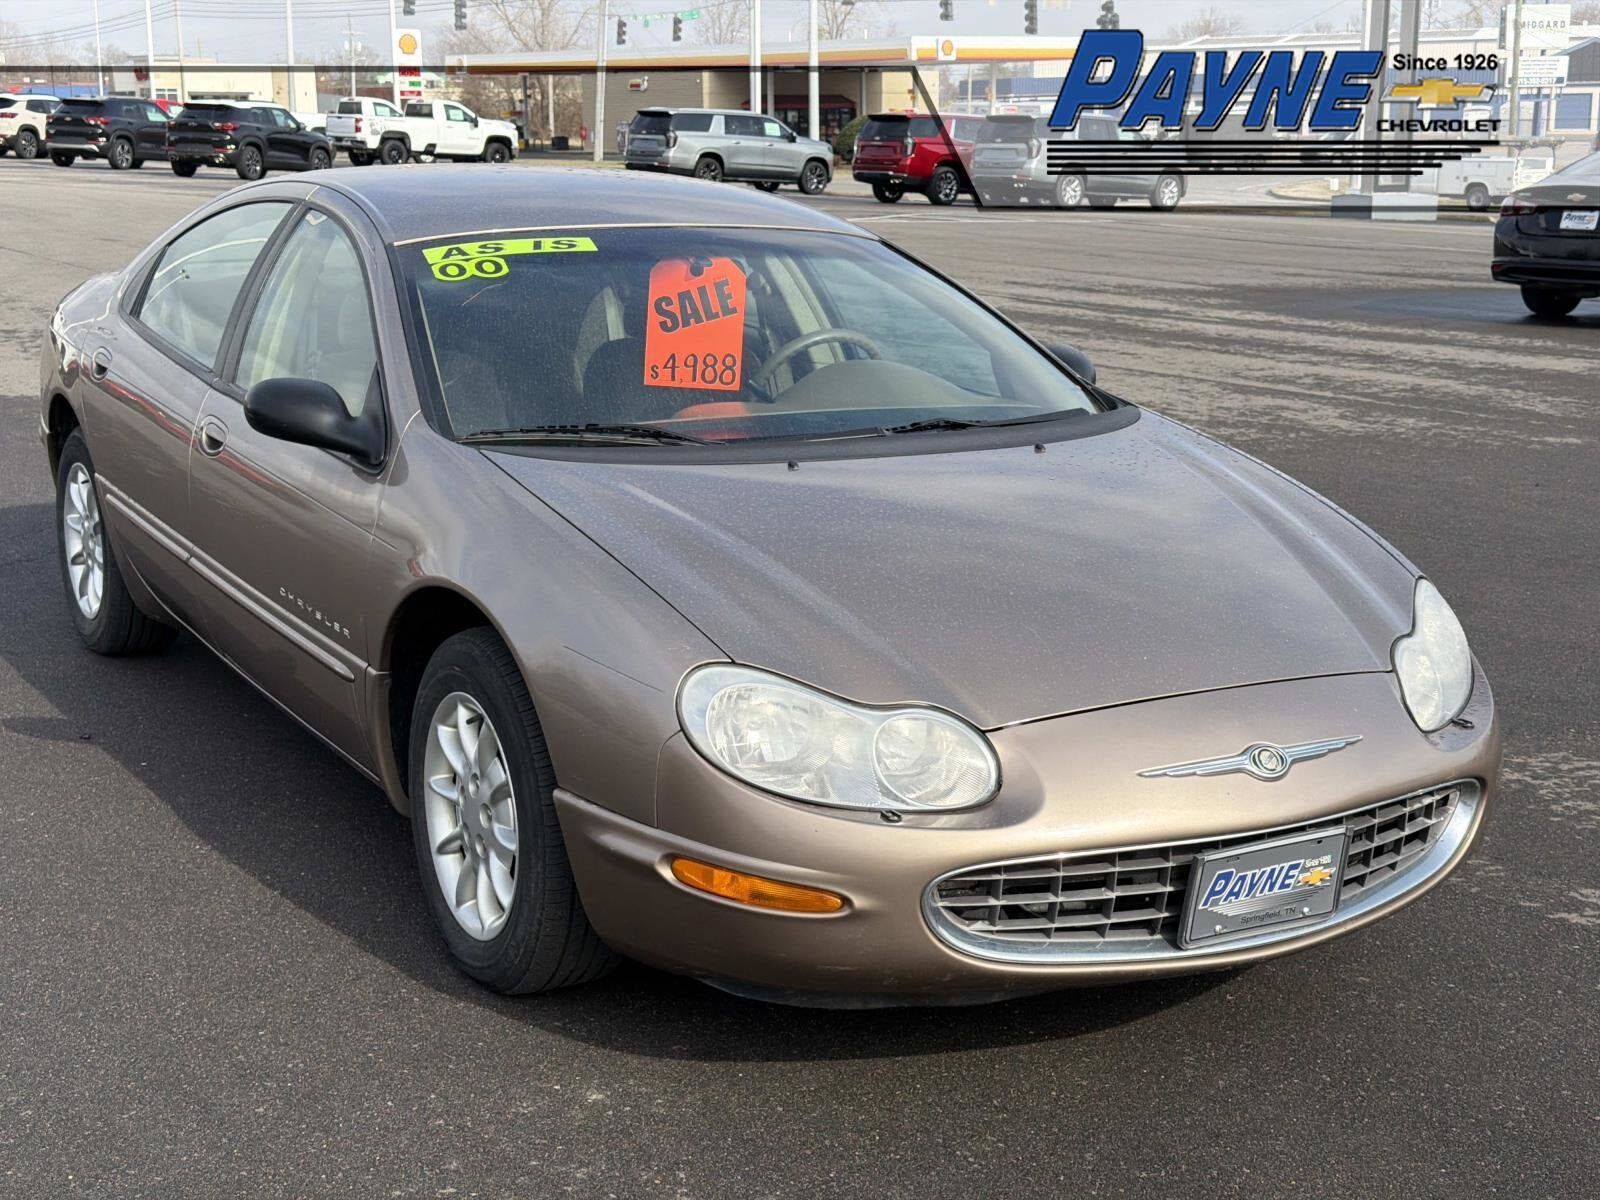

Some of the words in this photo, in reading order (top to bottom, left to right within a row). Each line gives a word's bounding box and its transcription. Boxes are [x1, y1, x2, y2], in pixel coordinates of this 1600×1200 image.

[441, 242, 505, 260] AS
[533, 239, 577, 251] IS
[653, 278, 738, 334] SALE
[650, 353, 737, 386] $4,988
[280, 587, 351, 639] CHRYSLER
[1199, 859, 1305, 910] PAYNE
[1285, 906, 1296, 915] TN
